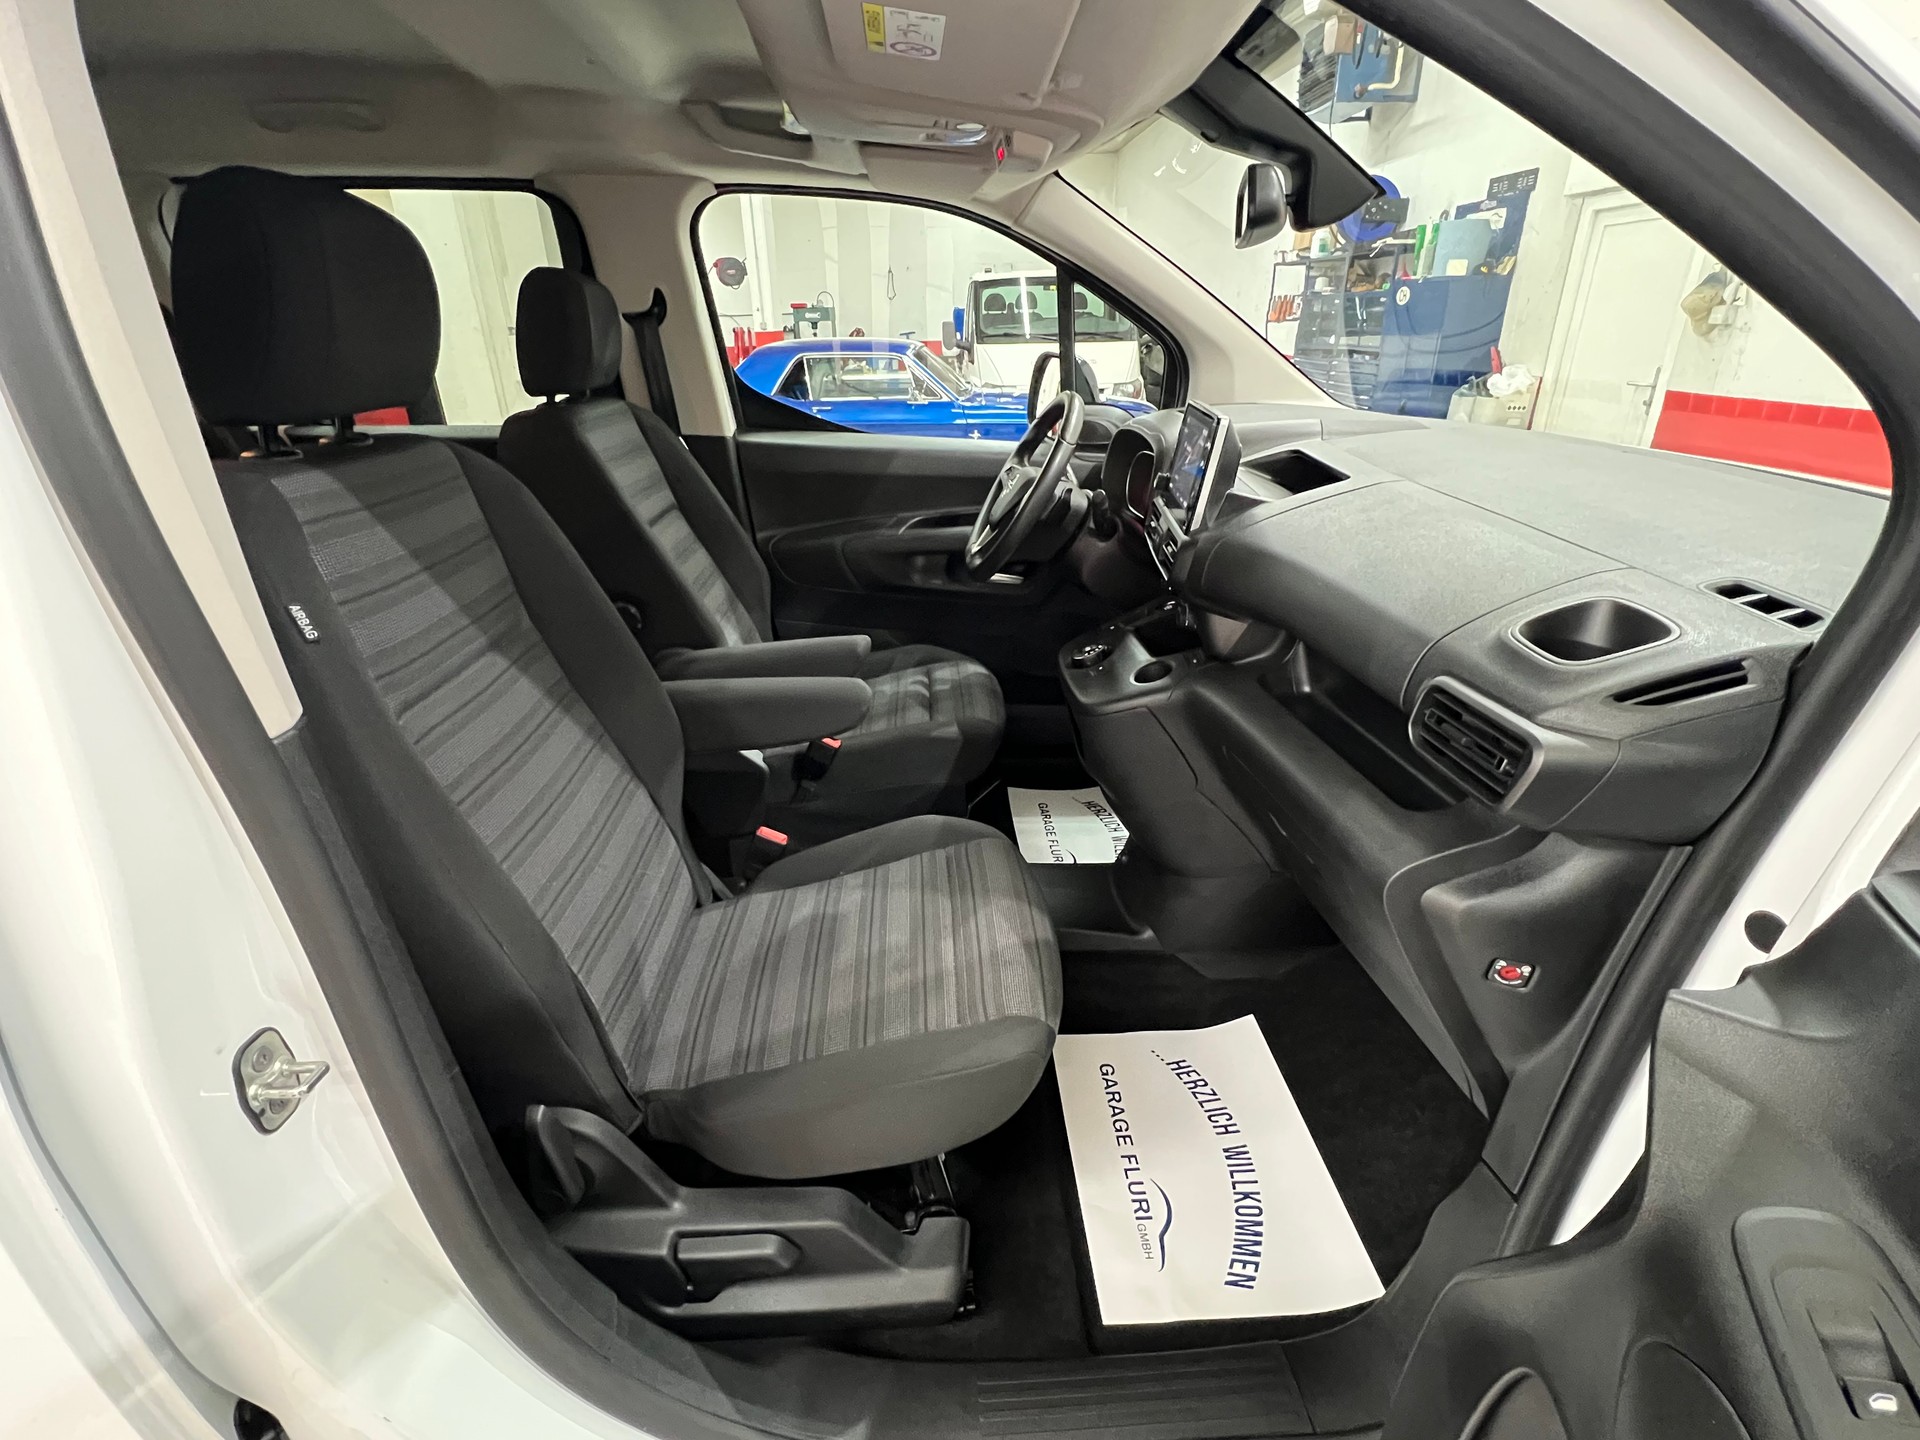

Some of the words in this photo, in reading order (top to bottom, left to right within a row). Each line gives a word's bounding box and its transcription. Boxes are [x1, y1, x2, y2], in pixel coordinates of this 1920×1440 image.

[288, 605, 318, 639] AIRBAG
[1038, 802, 1057, 837] GARAGE
[1099, 1062, 1134, 1148] GARAGE
[1120, 1153, 1153, 1221] FLURI
[1136, 1223, 1155, 1261] GMBH
[1222, 1144, 1264, 1290] WILLKOMMEN
